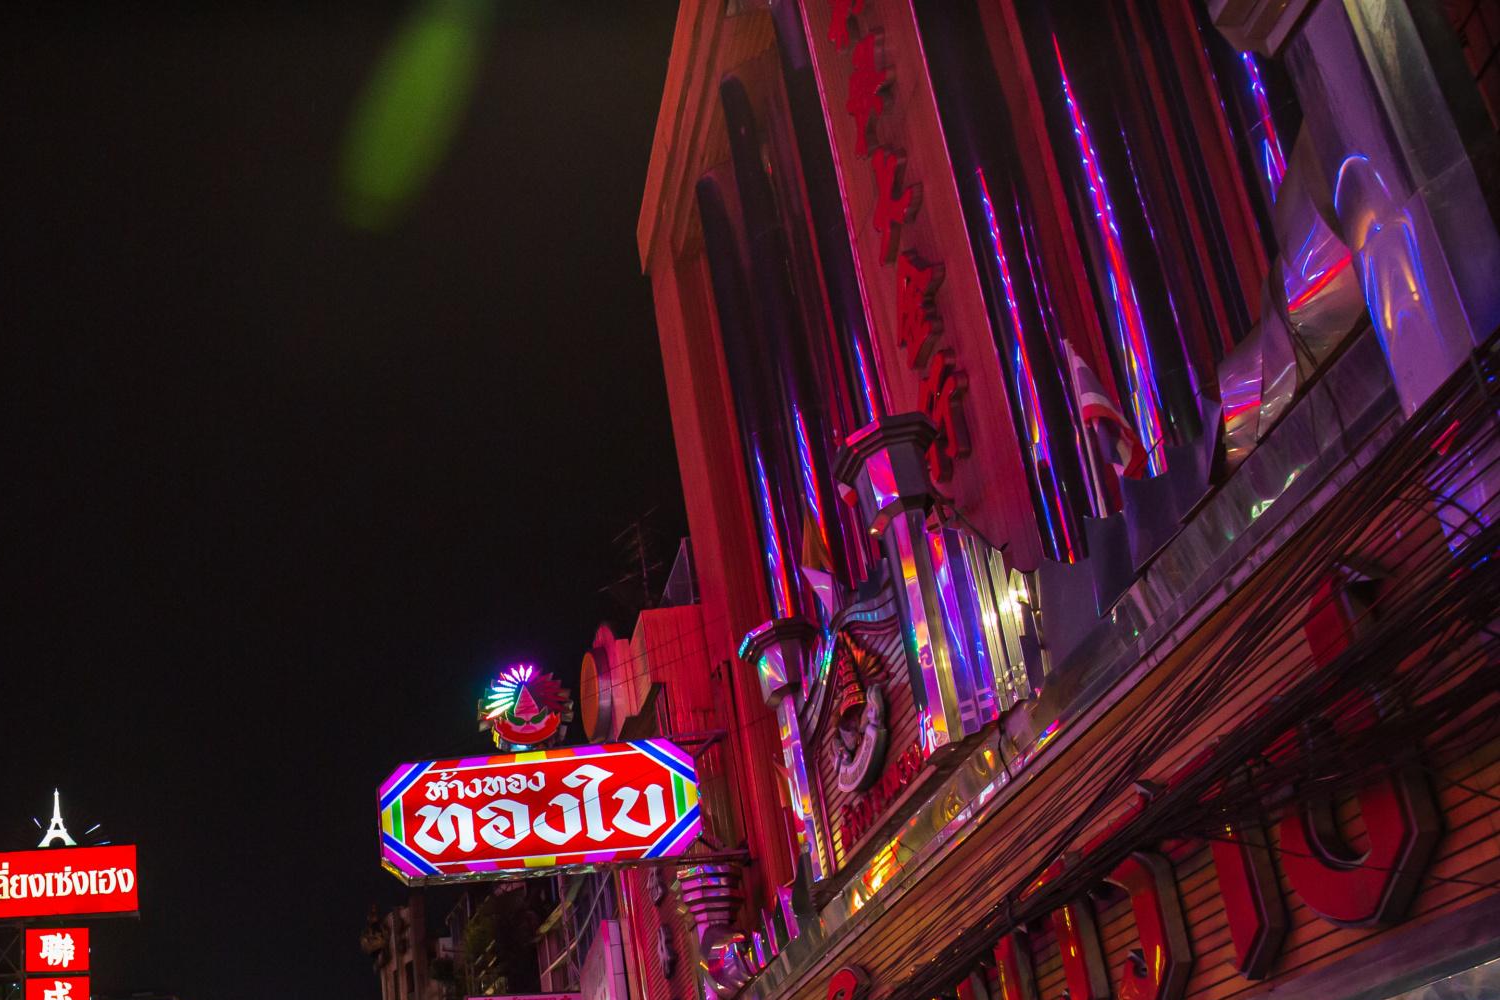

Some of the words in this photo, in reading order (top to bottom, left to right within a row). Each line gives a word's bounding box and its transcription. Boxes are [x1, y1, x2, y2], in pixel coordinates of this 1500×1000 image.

[414, 764, 664, 856] ทองใบ
[424, 770, 545, 801] ห้างทอง
